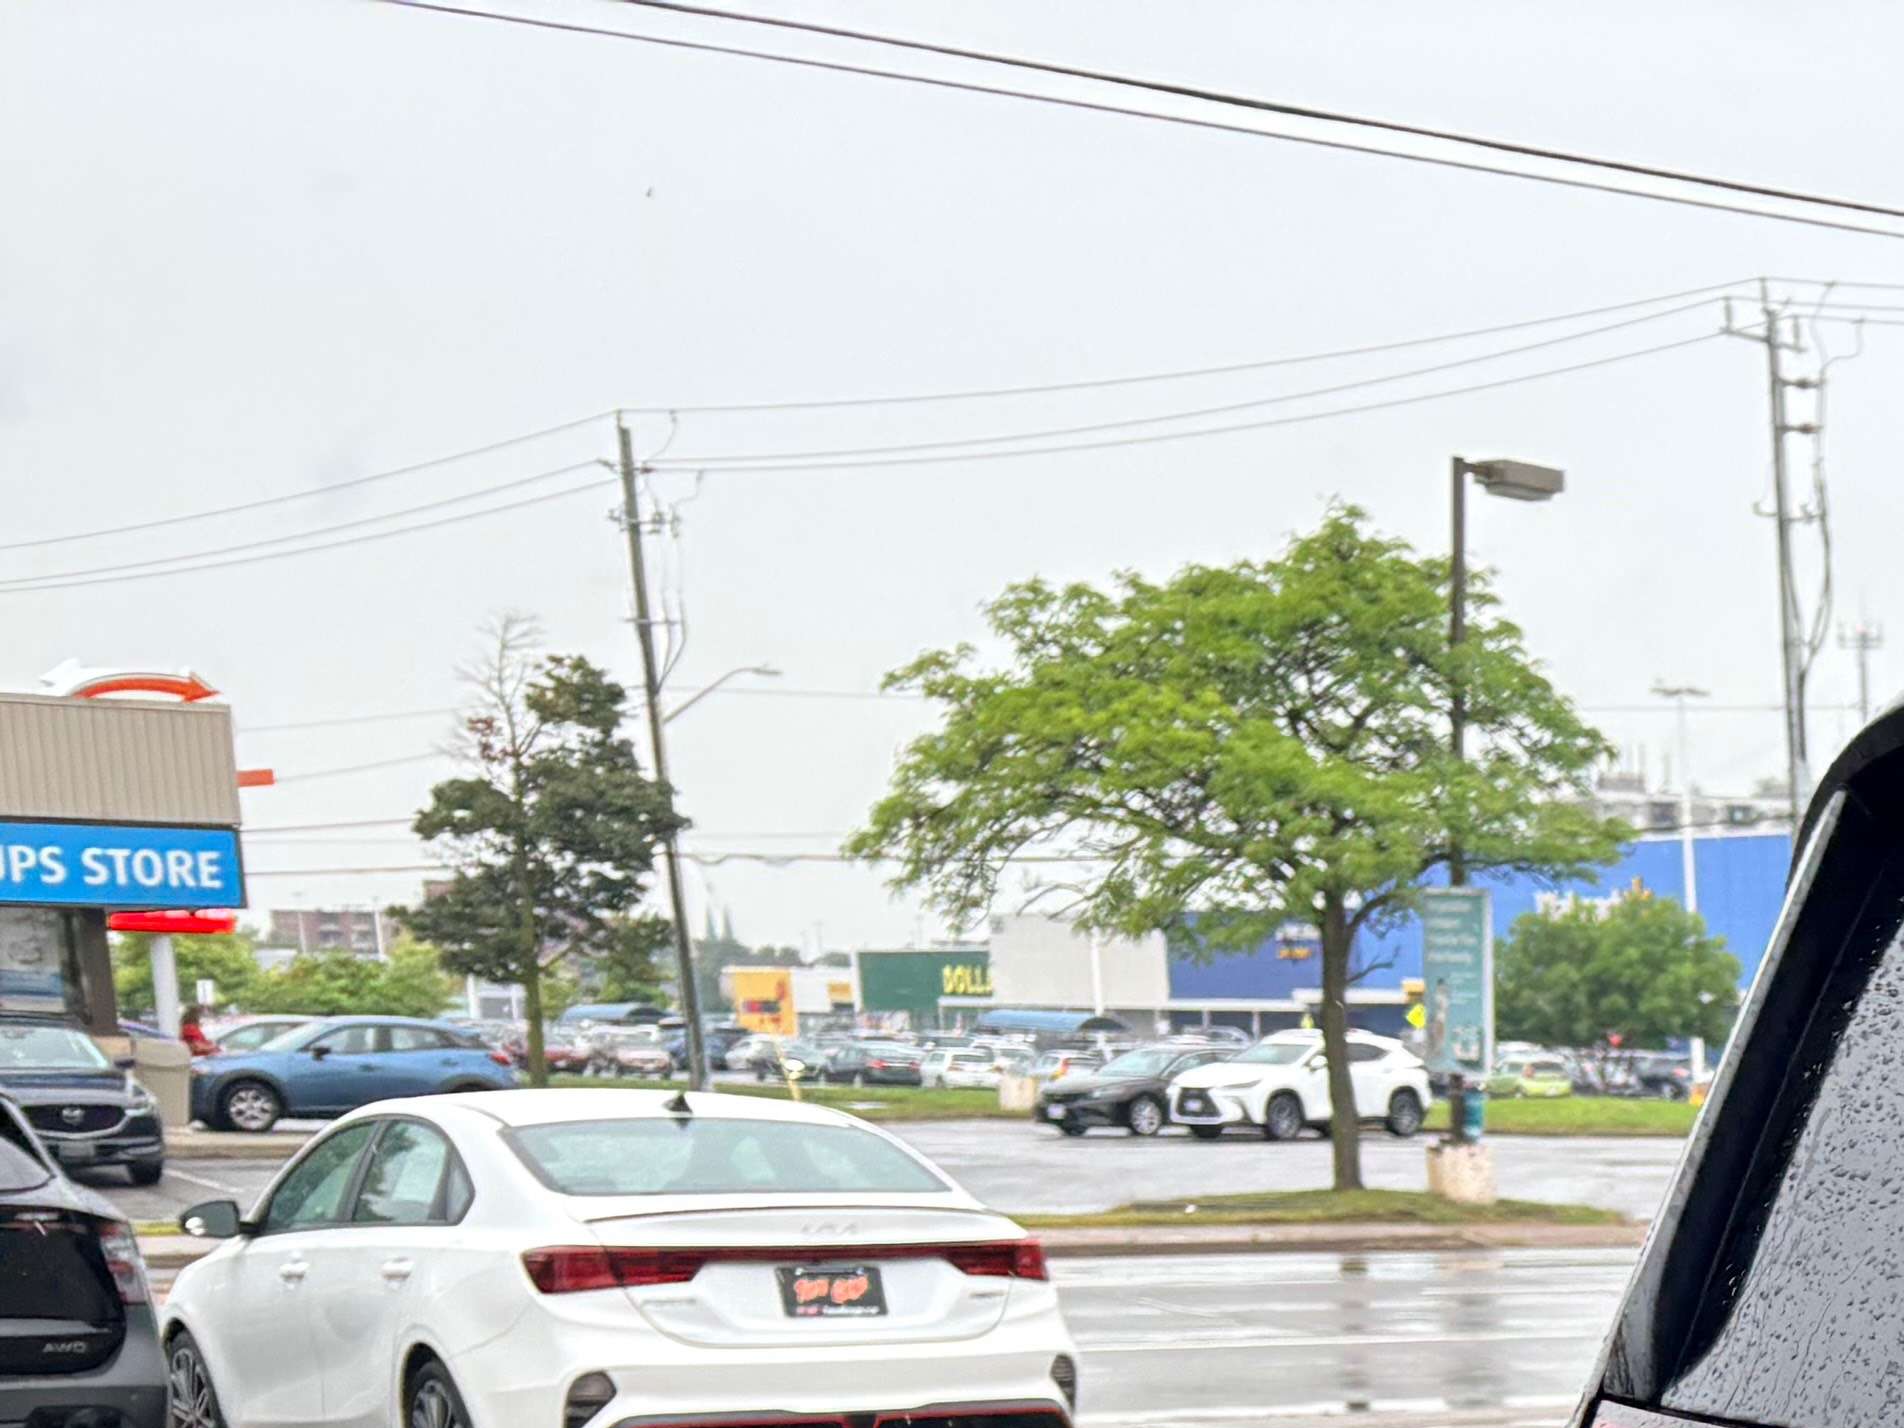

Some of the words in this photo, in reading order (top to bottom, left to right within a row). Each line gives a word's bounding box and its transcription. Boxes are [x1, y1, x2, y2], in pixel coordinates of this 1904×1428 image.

[0, 844, 66, 885] PS
[81, 847, 223, 889] STORE
[42, 1342, 87, 1353] AWD
